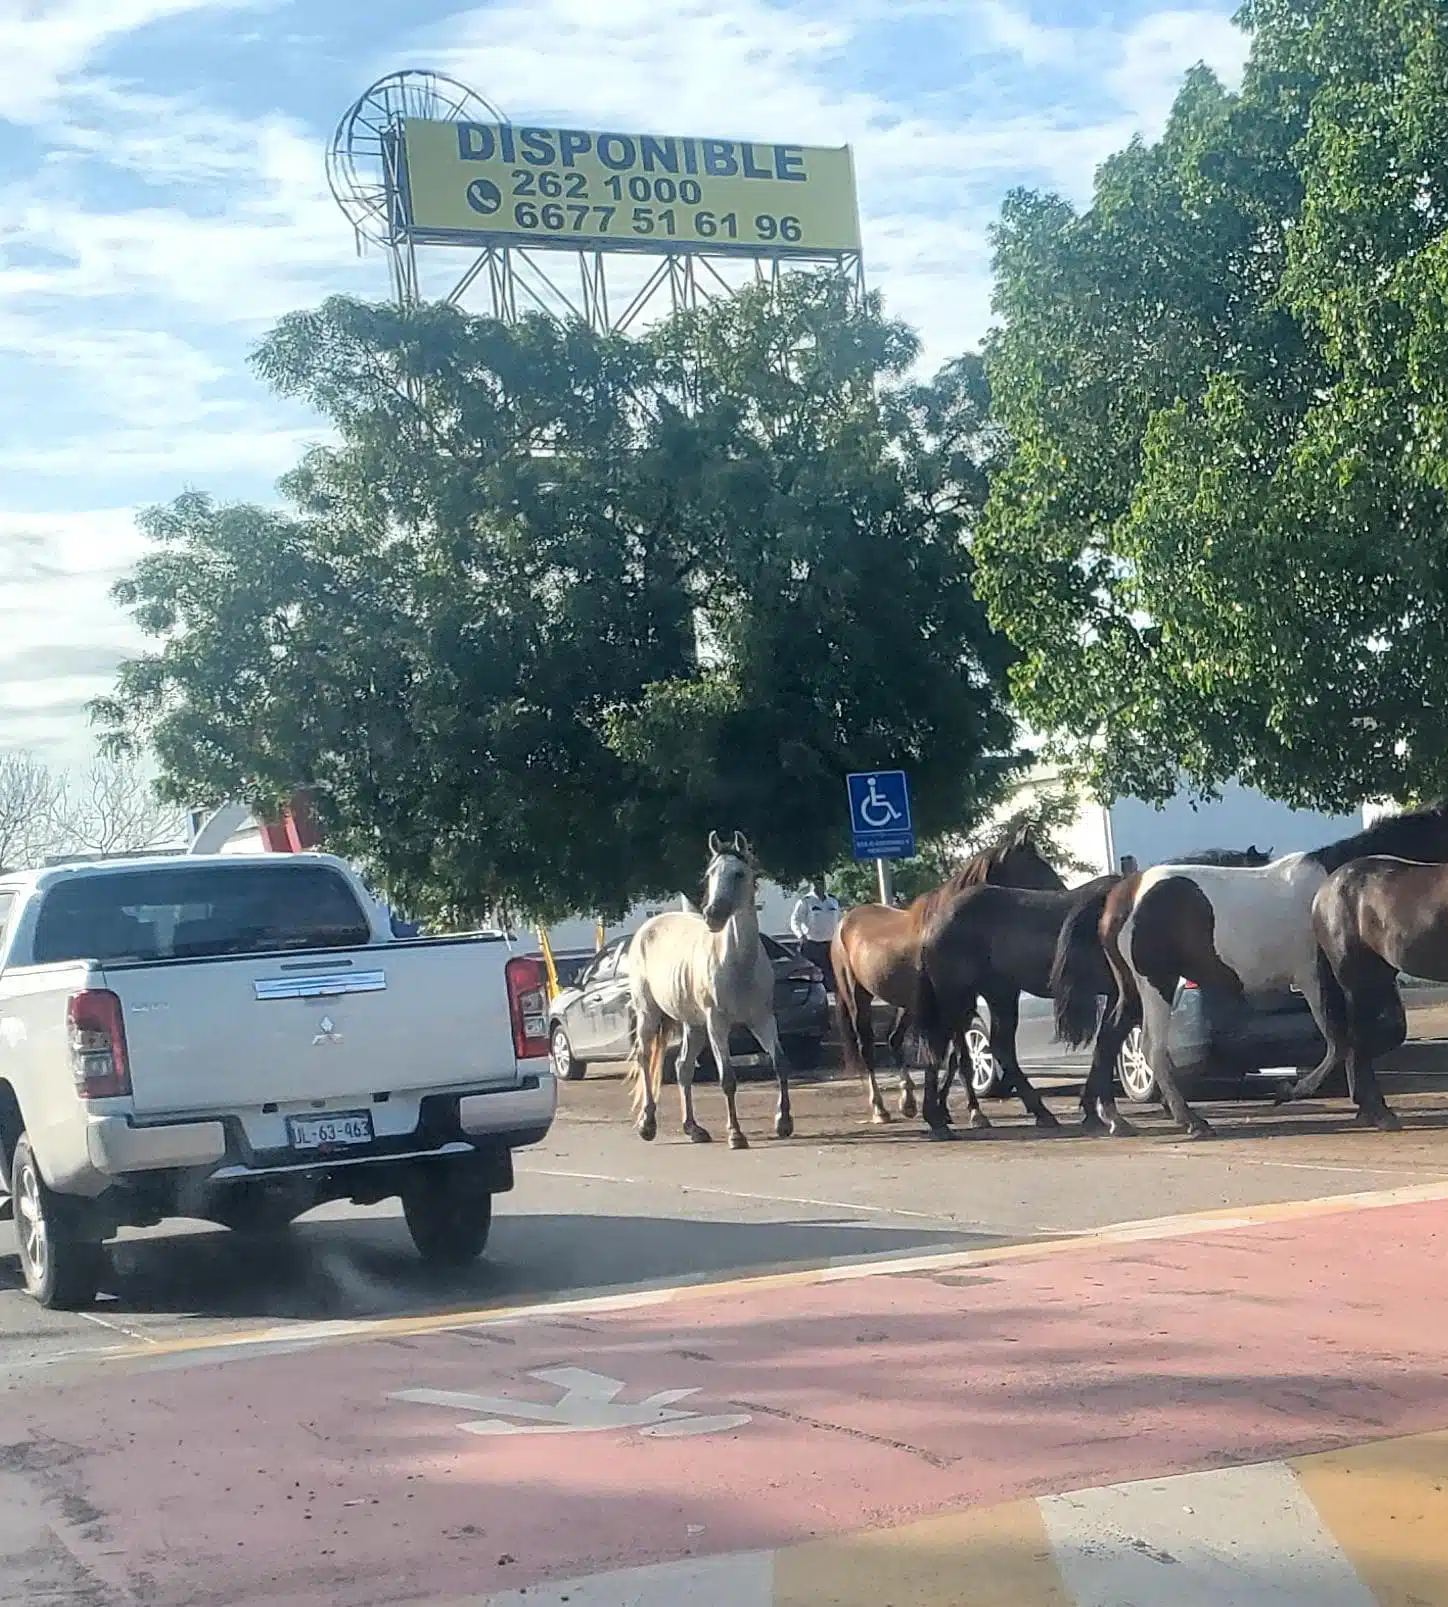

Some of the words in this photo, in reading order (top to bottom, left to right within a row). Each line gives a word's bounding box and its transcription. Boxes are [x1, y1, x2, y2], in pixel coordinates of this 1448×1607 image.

[457, 122, 807, 182] DISPONIBLE
[511, 169, 589, 199] 262
[604, 175, 702, 205] 1000
[514, 202, 617, 233] 6677
[632, 207, 676, 235] 51
[694, 211, 738, 239] 61
[755, 214, 803, 242] 96
